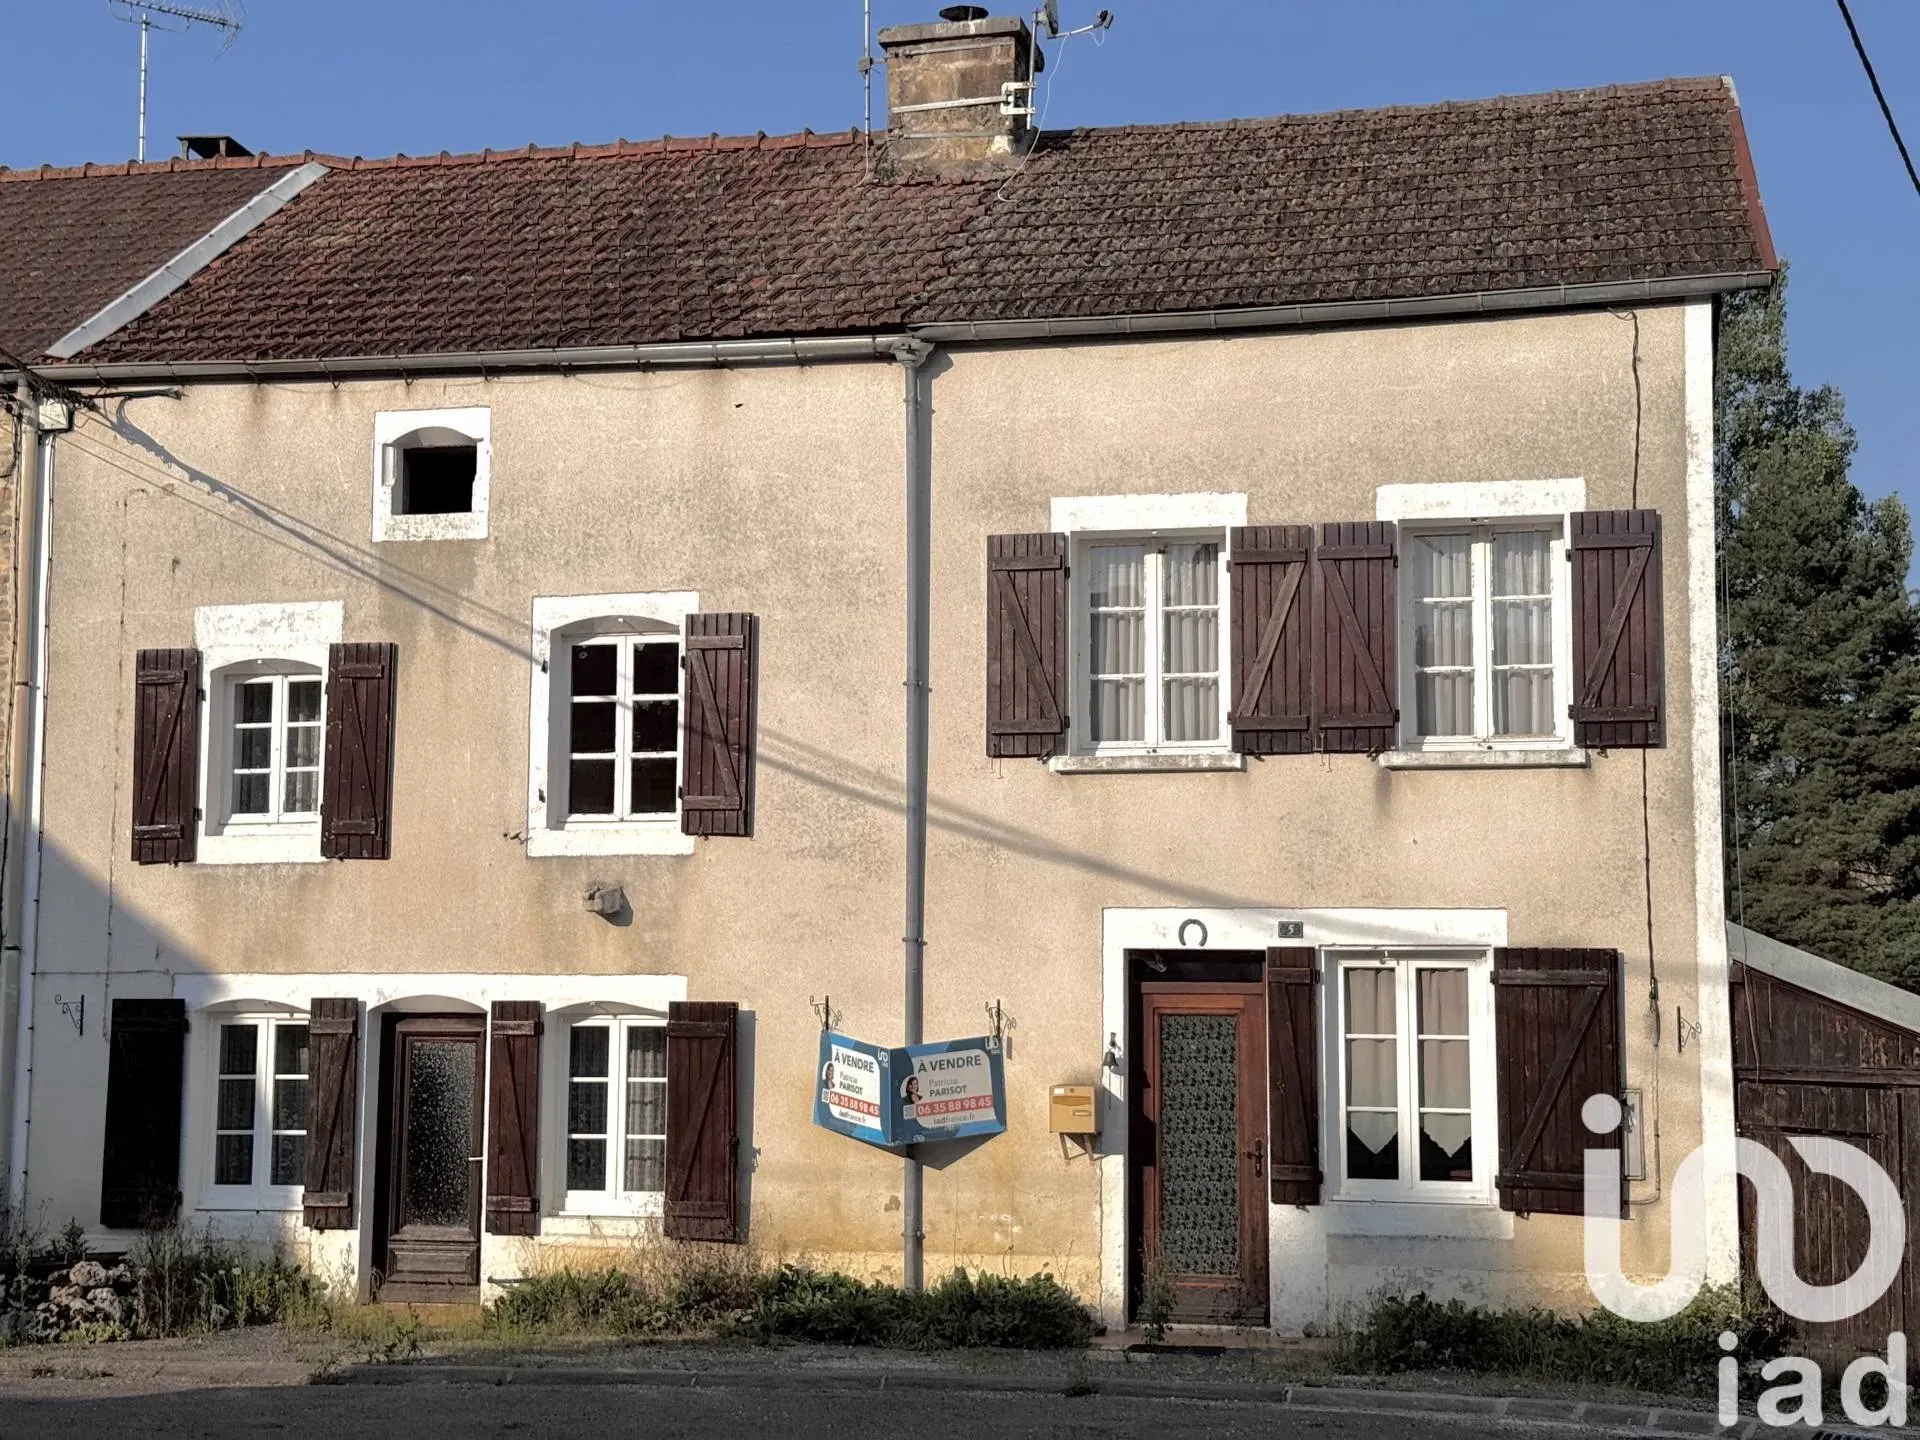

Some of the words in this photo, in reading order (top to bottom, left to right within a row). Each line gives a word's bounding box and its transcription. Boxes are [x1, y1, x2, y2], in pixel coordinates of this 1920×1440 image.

[1287, 924, 1295, 935] 5
[834, 1048, 840, 1064] À
[842, 1053, 875, 1074] VENDRE
[918, 1059, 928, 1073] À
[930, 1055, 982, 1072] VENDRE
[839, 1080, 863, 1096] PARISOT
[929, 1076, 958, 1088] Patricia
[929, 1085, 967, 1097] PARISOT
[830, 1093, 840, 1105] 06
[840, 1095, 849, 1107] 35
[850, 1098, 858, 1110] 88
[859, 1101, 868, 1113] 98
[869, 1105, 879, 1117] 45
[917, 1105, 931, 1116] 06
[933, 1102, 946, 1113] 35
[948, 1100, 961, 1111] 88
[963, 1099, 976, 1109] 98
[978, 1096, 992, 1107] 45
